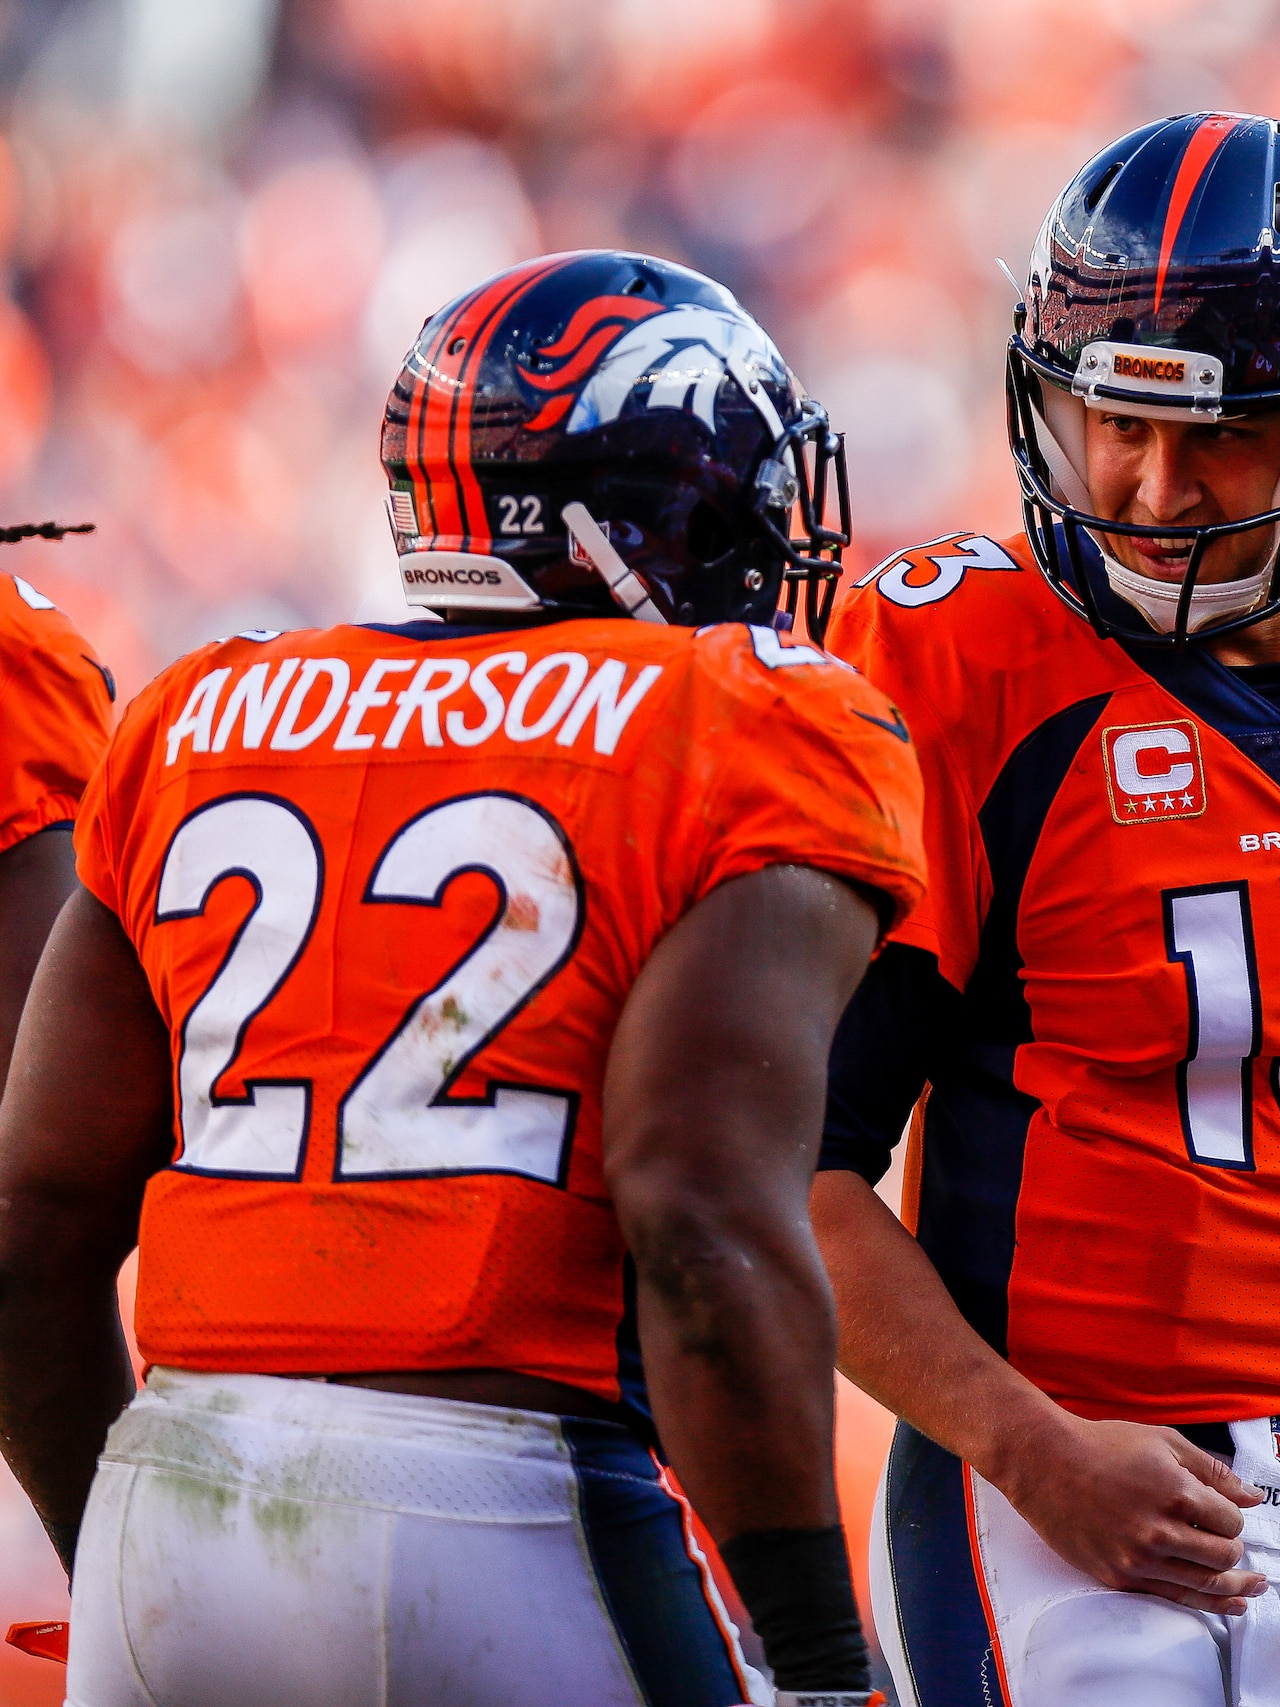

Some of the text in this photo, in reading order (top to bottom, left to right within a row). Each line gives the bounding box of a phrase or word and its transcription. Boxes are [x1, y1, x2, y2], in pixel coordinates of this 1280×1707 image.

[1114, 354, 1186, 381] BRONCOS
[499, 494, 545, 534] 22
[404, 568, 502, 586] BRONCOS
[164, 651, 664, 767] ANDERSON
[1112, 727, 1195, 796] C
[154, 790, 585, 1190] 22
